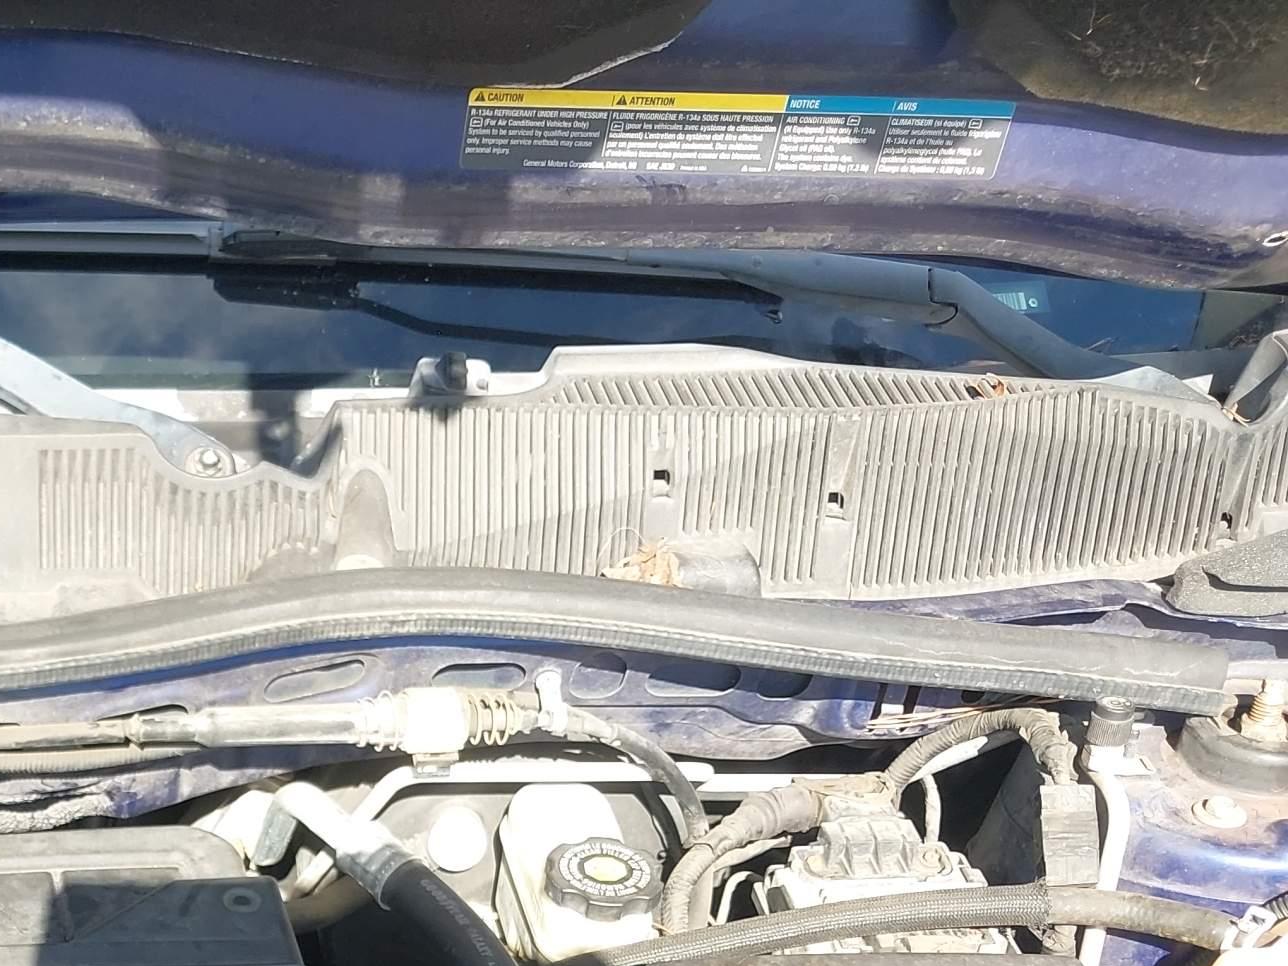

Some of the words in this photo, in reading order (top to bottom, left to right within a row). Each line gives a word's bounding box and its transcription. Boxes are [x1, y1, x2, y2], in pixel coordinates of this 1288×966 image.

[488, 92, 524, 102] CAUTION
[629, 96, 675, 106] ATTENTION
[790, 99, 821, 109] NOTICE
[896, 102, 918, 111] AVIS
[471, 108, 494, 116] R-134a
[494, 109, 536, 117] REFRIGERANT
[537, 110, 559, 118] UNDER
[560, 110, 575, 118] HIGH
[576, 111, 608, 119] PRESSURE
[678, 113, 700, 121] R-134a
[702, 114, 719, 122] SOUS
[720, 114, 741, 122] HAUTE
[742, 115, 774, 123] PRESSION
[484, 118, 496, 126] (For
[508, 119, 545, 127] Conditioned
[546, 120, 572, 128] Vehicles
[573, 120, 590, 129] Only)
[786, 116, 798, 124] AIR
[799, 116, 845, 124] CONDITIONING
[891, 118, 933, 126] CLIMATISEUR
[626, 122, 642, 131] (pour
[727, 124, 735, 132] de
[839, 127, 852, 135] only
[468, 128, 490, 136] System
[535, 129, 542, 138] by
[543, 130, 569, 138] qualified
[570, 131, 600, 139] personnel
[465, 147, 491, 155] personal
[547, 160, 567, 168] Motors
